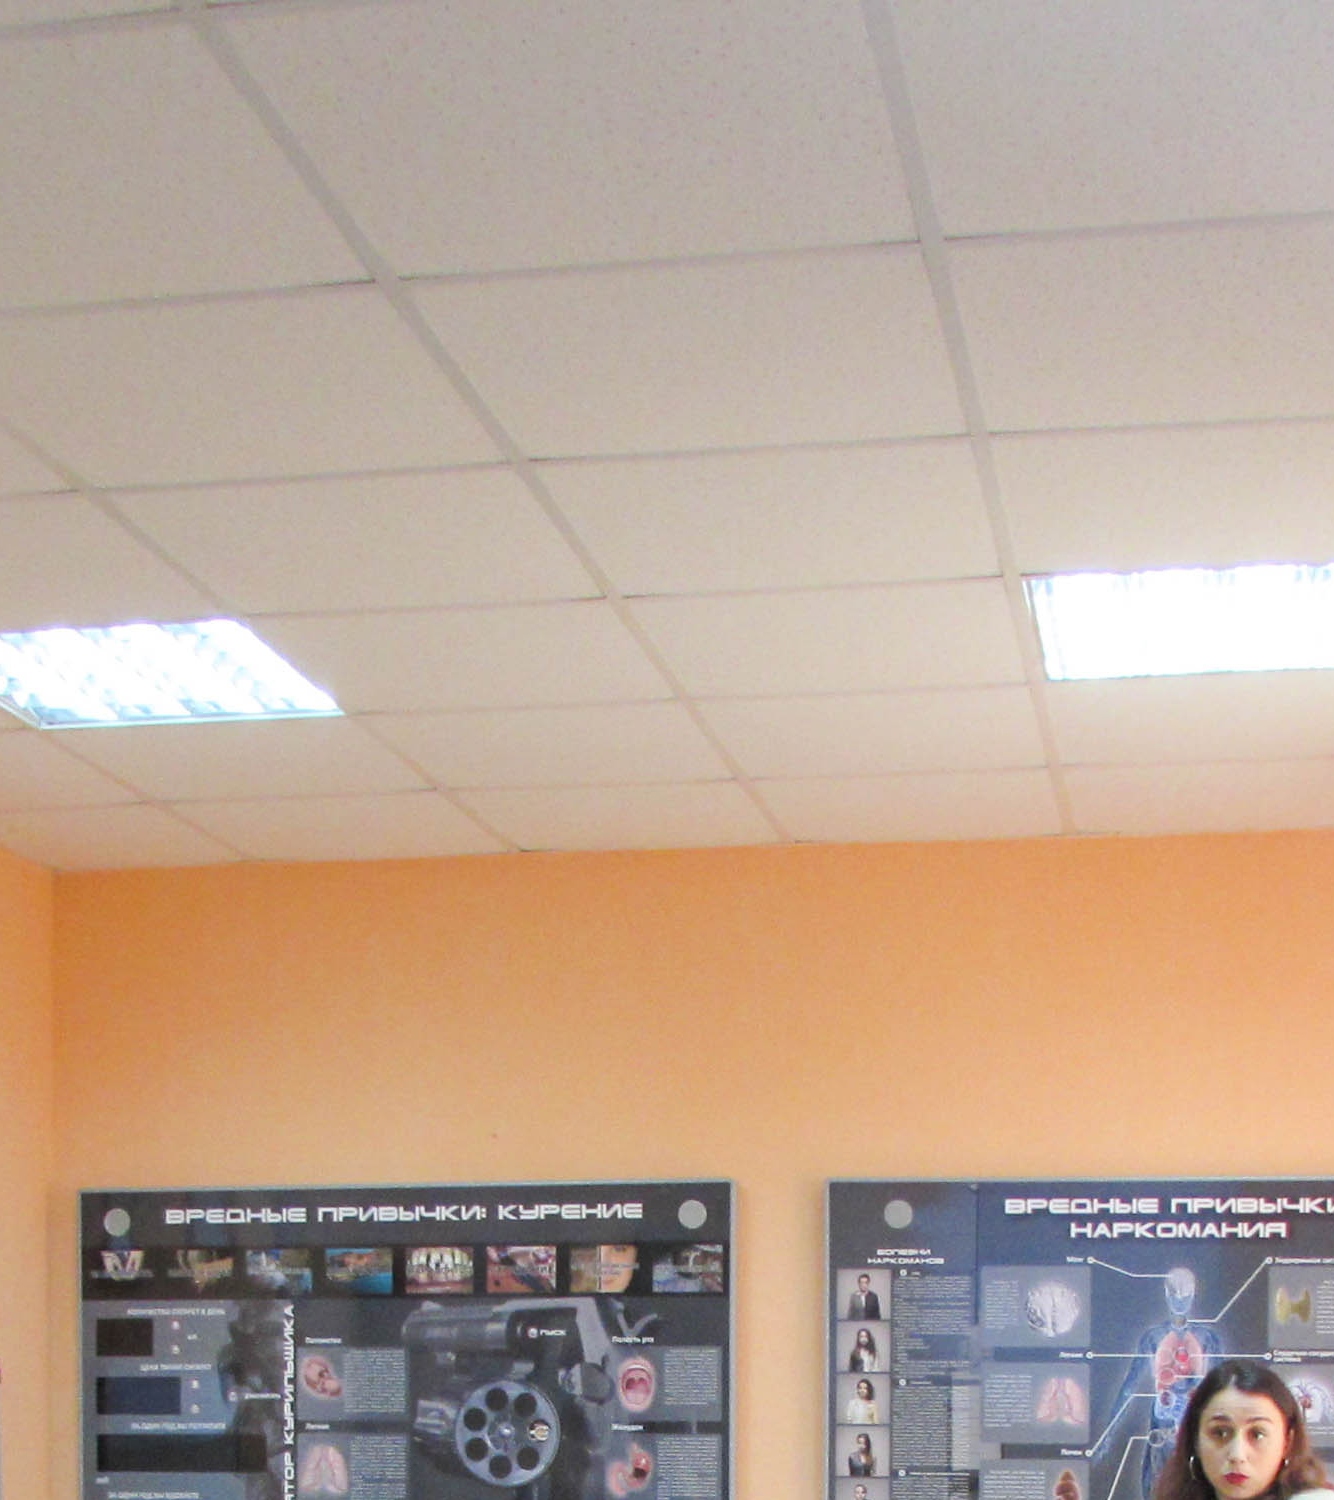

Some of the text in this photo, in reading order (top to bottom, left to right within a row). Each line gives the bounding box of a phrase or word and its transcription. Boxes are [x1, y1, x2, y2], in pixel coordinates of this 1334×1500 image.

[165, 1203, 644, 1224] ВРЕДНЫЕ ПРИВЫЧКИ: КУРЕНИЕ
[1004, 1198, 1159, 1214] ВРЕДНЫЕ
[1070, 1222, 1286, 1238] НАРКОМАНИЯ
[867, 1257, 945, 1265] НАРКОМАНОВ
[282, 1304, 295, 1445] КУРИЛЬЩИКА
